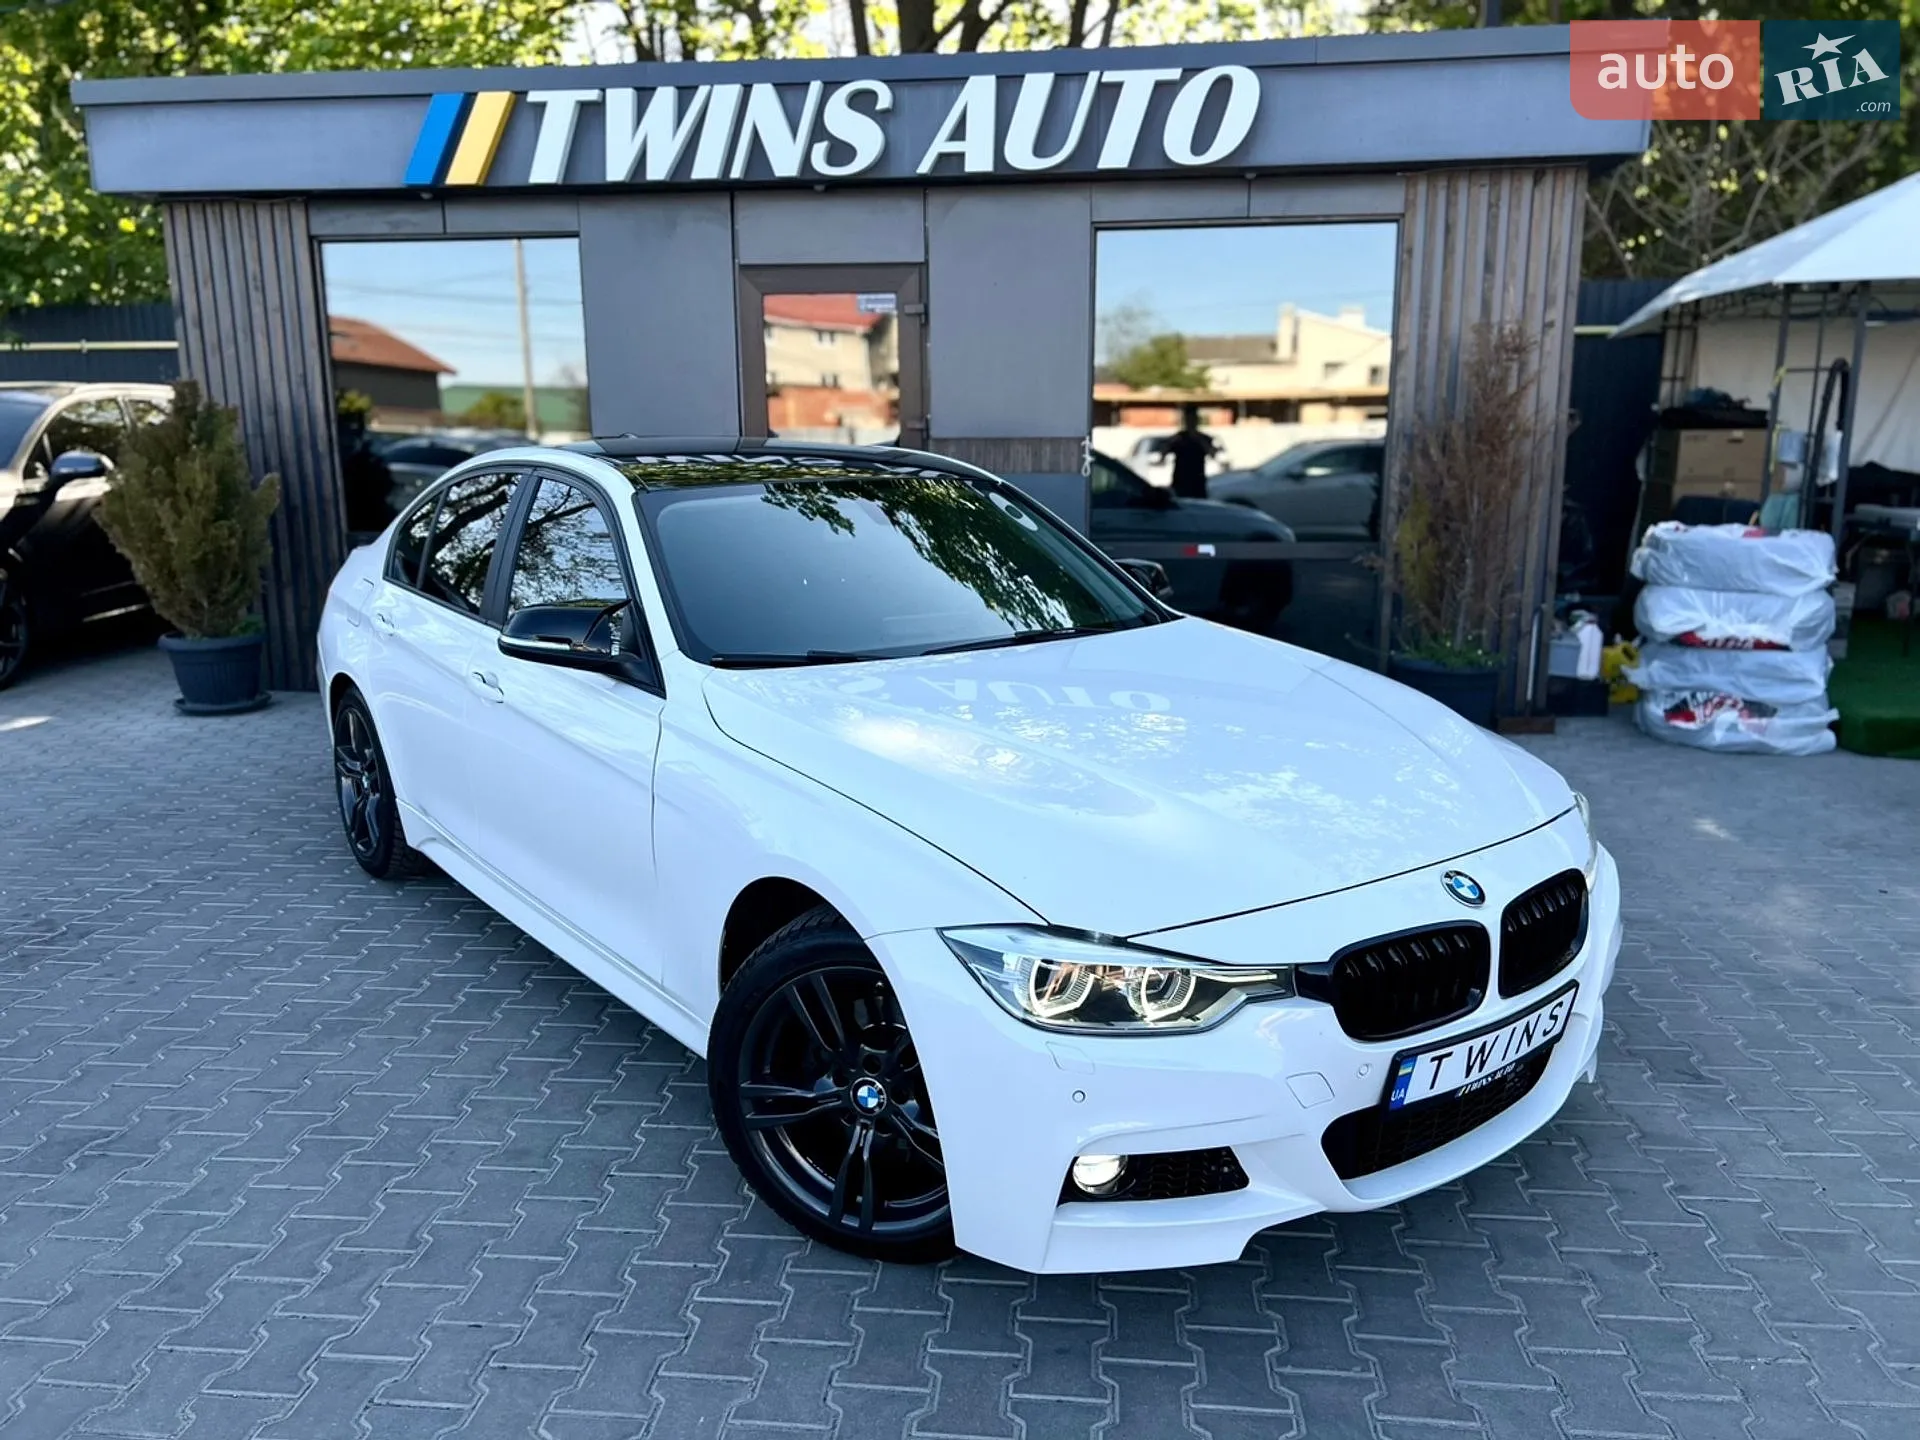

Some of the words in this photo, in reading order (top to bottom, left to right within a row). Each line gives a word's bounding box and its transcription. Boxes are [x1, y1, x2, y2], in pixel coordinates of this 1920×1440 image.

[526, 79, 894, 185] TWINS
[916, 64, 1262, 175] AUTO
[1390, 1087, 1405, 1102] UA
